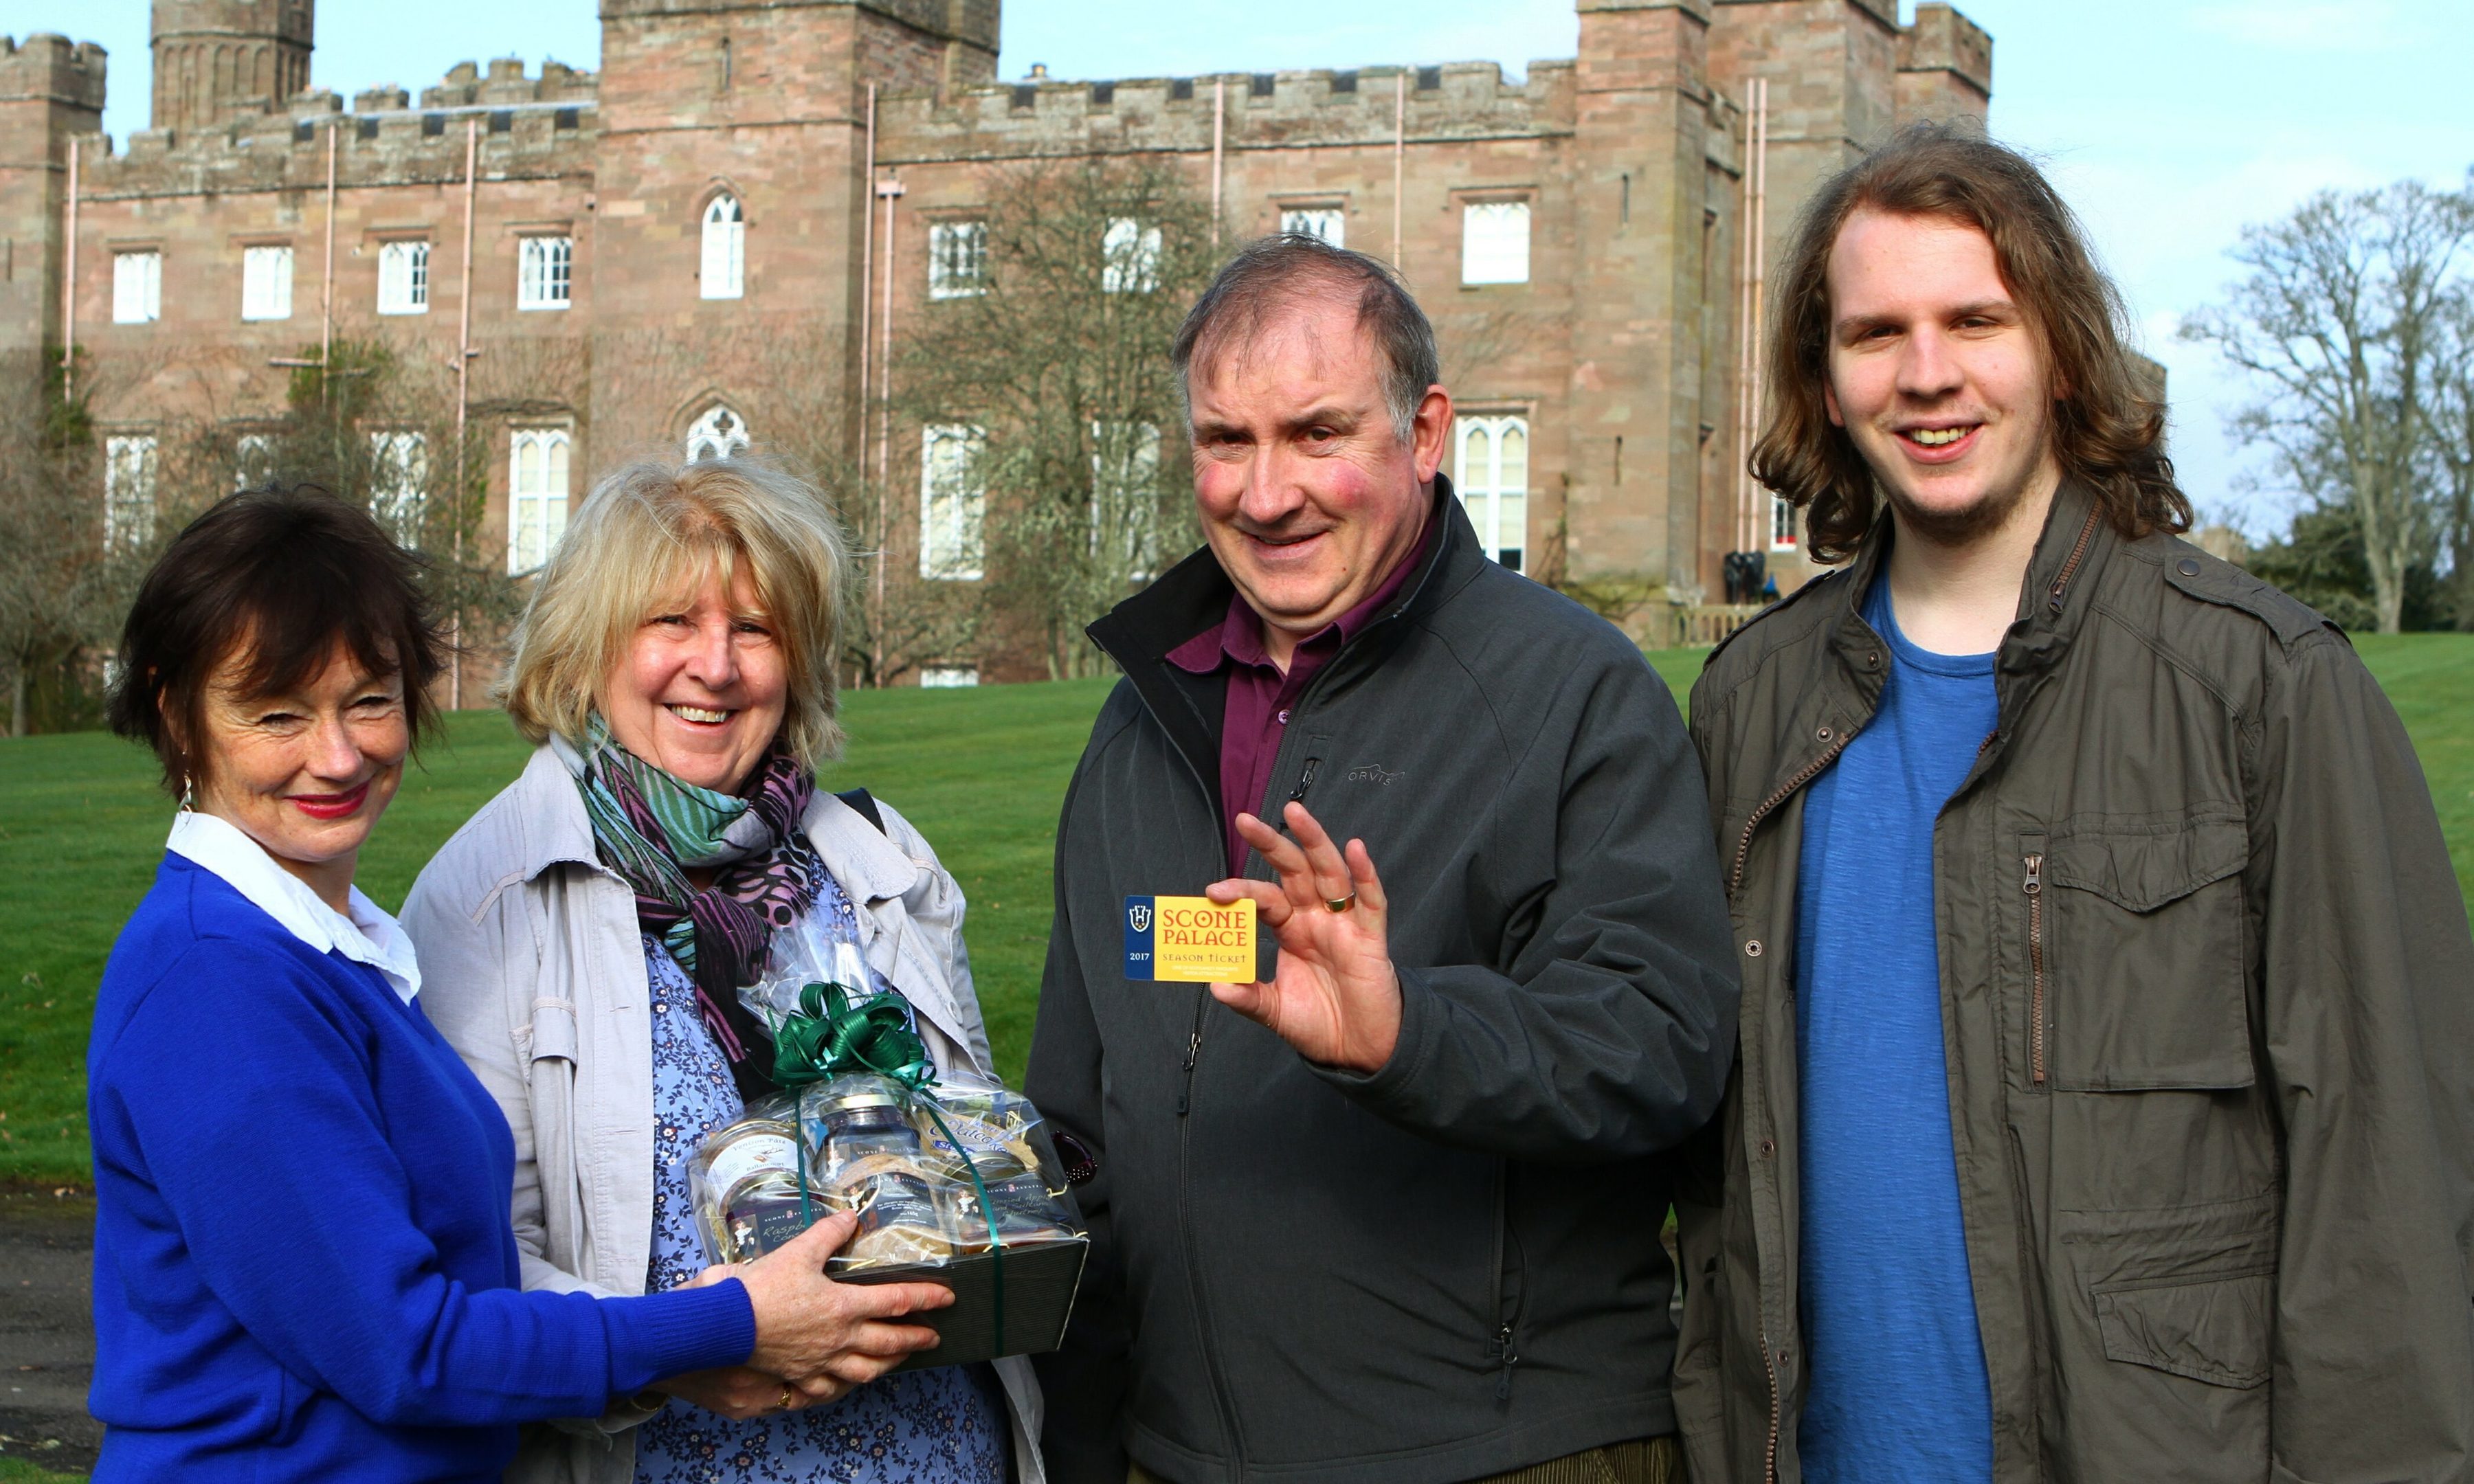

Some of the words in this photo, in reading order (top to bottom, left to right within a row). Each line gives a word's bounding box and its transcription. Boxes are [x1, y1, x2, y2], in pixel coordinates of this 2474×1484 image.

[1348, 771, 1392, 786] ORVIS
[1163, 909, 1247, 929] SCONE
[1163, 929, 1248, 947] PALACE
[1129, 952, 1150, 961] 2017
[1162, 953, 1204, 962] SEASON
